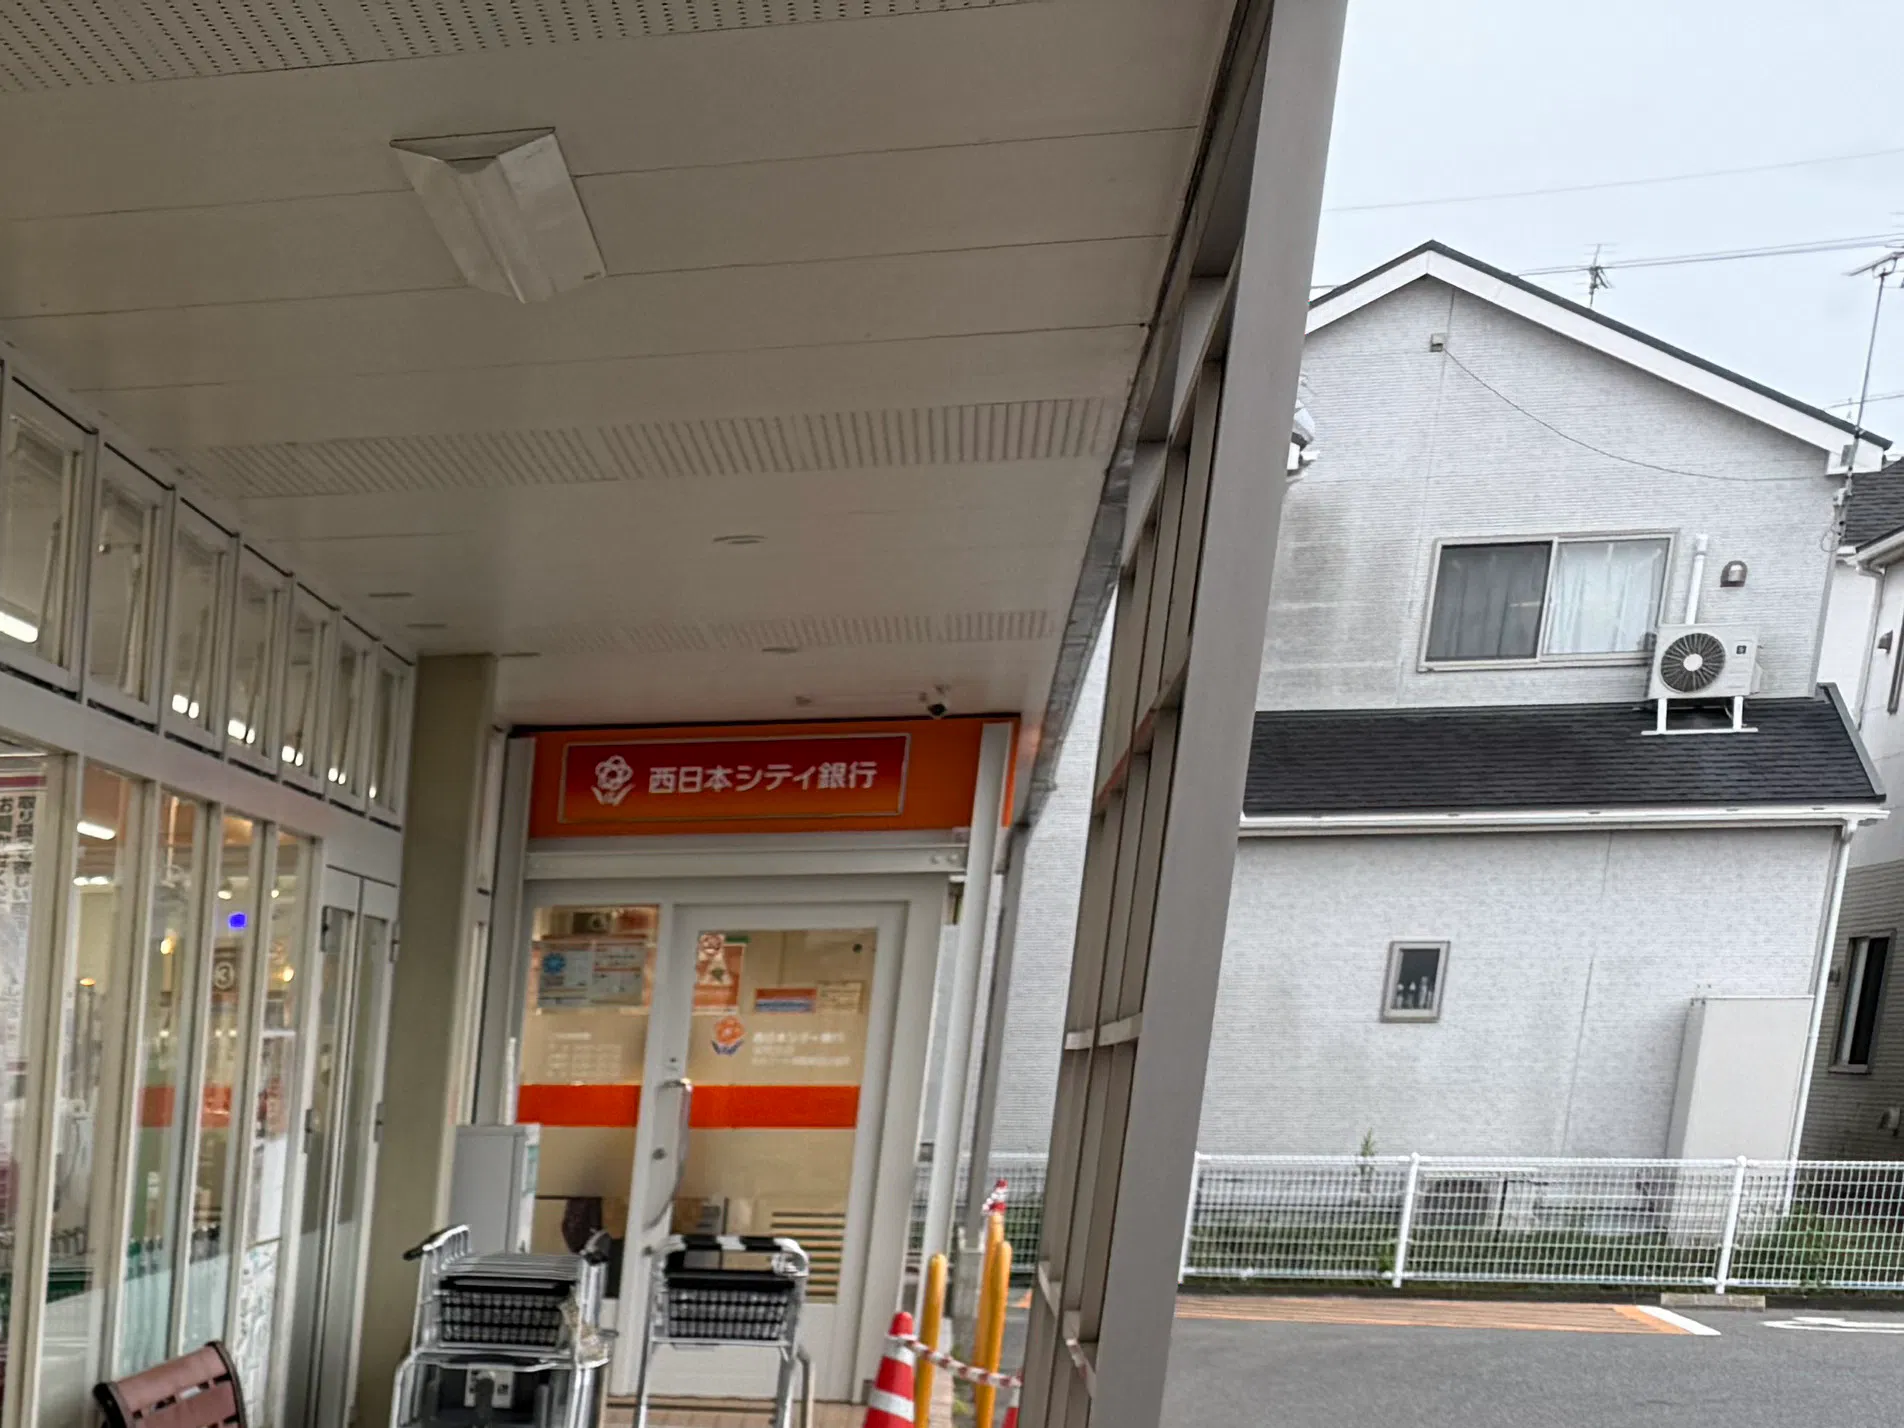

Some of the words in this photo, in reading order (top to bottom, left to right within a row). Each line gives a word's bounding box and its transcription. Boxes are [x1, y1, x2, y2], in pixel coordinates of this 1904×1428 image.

[648, 761, 877, 794] 西日本シティ銀行
